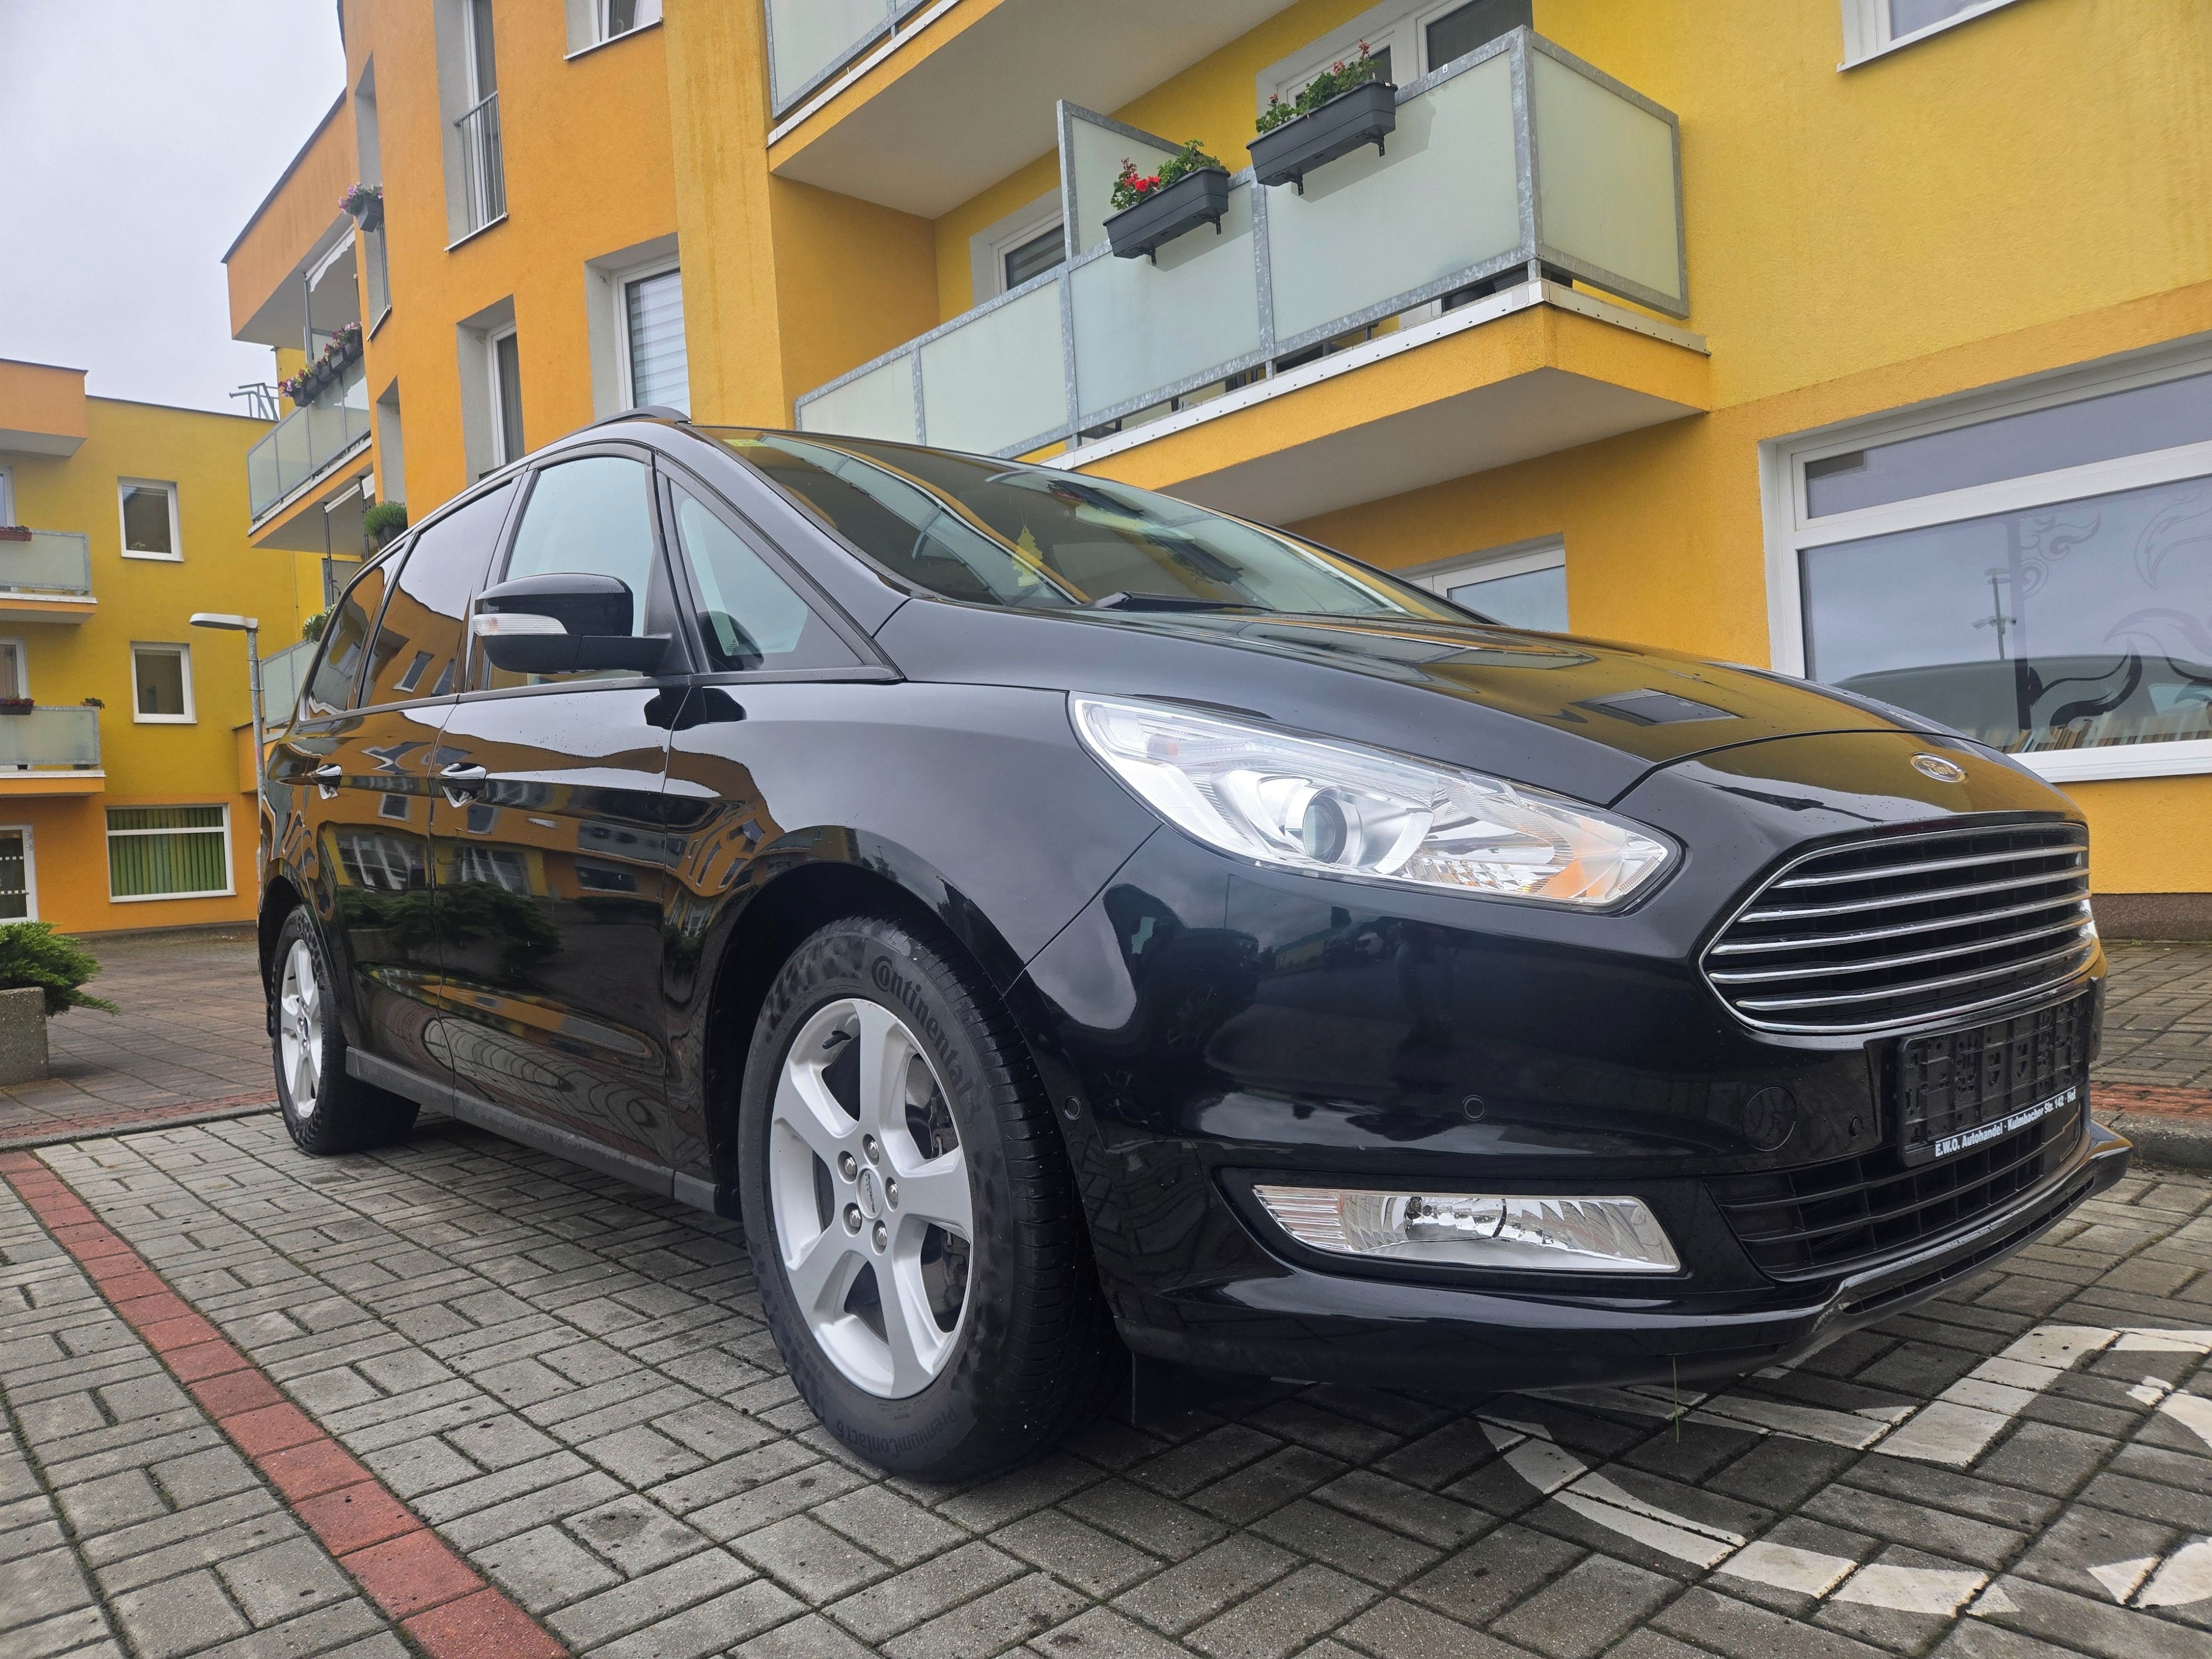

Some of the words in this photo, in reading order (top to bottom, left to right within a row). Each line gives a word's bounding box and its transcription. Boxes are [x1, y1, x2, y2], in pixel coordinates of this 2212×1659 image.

[1922, 760, 1955, 775] Ford
[872, 955, 974, 1098] Continental
[1935, 1138, 1960, 1157] E.W.O.
[1961, 1122, 2003, 1149] Autohandel
[2007, 1108, 2044, 1131] Kulmbacher
[2044, 1102, 2054, 1114] Str.
[2054, 1095, 2064, 1109] 142
[2067, 1088, 2077, 1103] Hof
[836, 1420, 844, 1438] 6
[847, 1407, 958, 1458] PremiumContact
